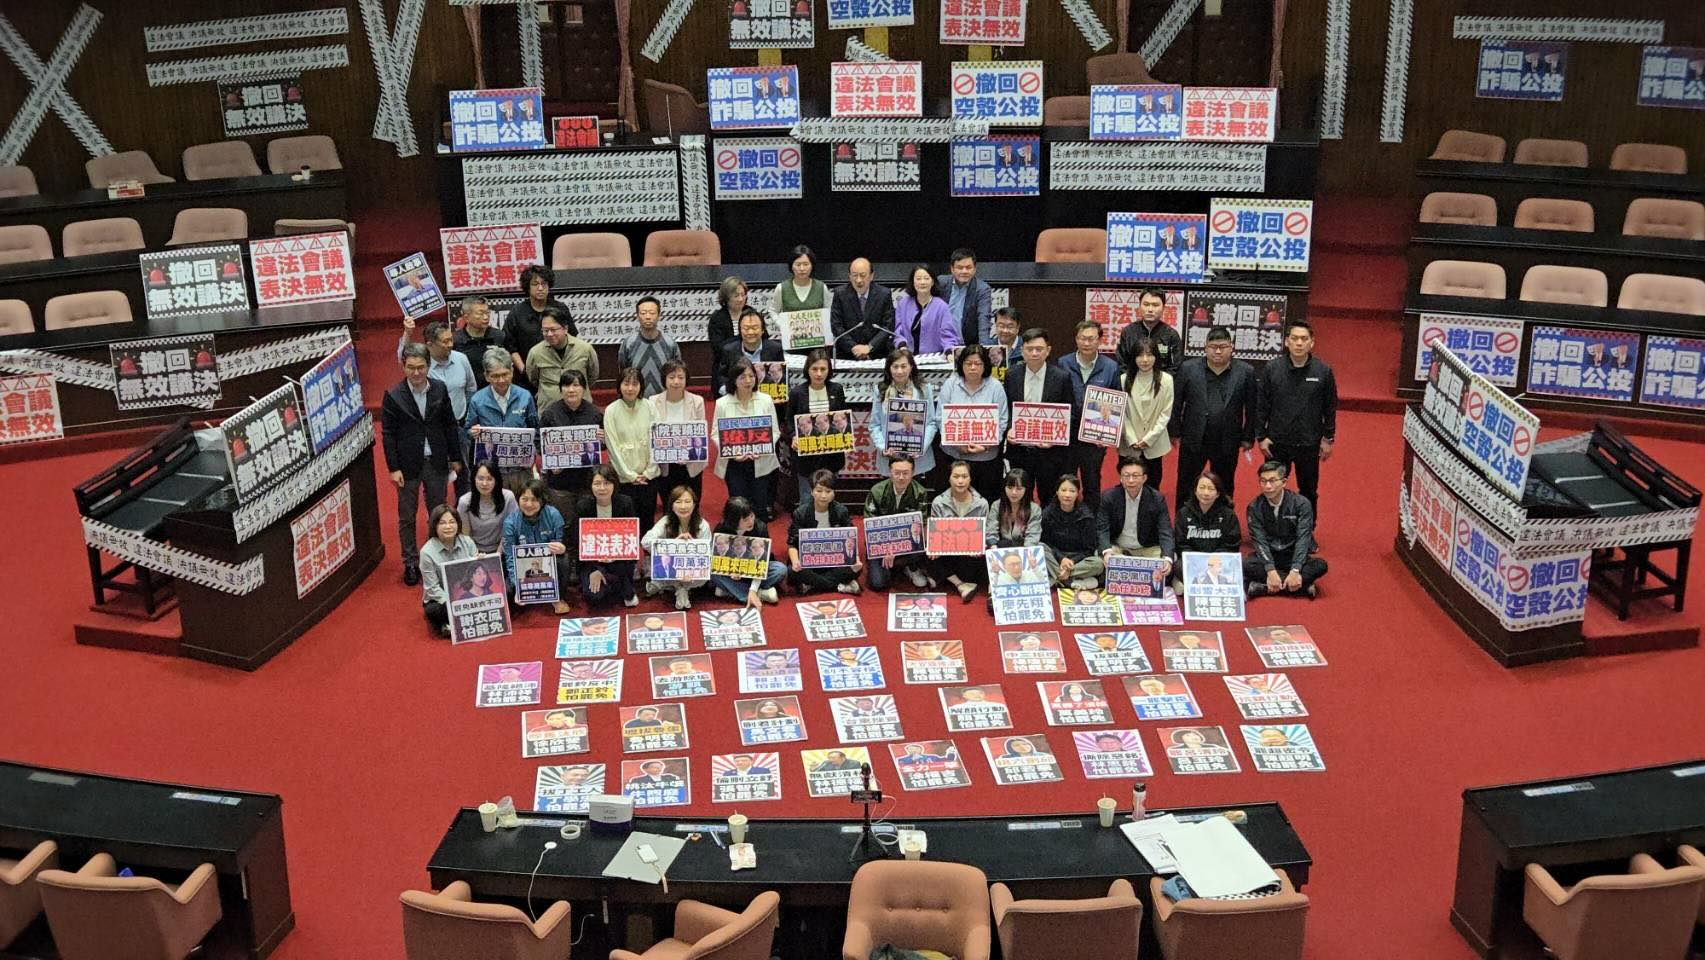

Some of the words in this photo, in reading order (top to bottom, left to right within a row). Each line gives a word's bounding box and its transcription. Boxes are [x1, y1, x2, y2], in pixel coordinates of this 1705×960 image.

[945, 0, 1021, 18] 違法會議
[730, 18, 811, 39] 無效議決
[945, 19, 1021, 39] 表決無效
[1482, 50, 1524, 72] 撤回
[1645, 56, 1688, 78] 撤回
[710, 76, 753, 100] 撤回
[836, 75, 916, 94] 違法會議
[976, 74, 1016, 94] 撤回
[1479, 71, 1564, 95] 詐騙公投
[242, 84, 284, 108] 撤回
[836, 94, 917, 113] 表決無效
[954, 96, 1040, 117] 空殼公投
[1092, 94, 1136, 114] 撤回
[453, 99, 497, 124] 撤回
[711, 100, 798, 123] 詐騙公投
[1186, 100, 1270, 120] 違法會議
[454, 122, 543, 147] 詐騙公投
[1093, 114, 1179, 134] 詐騙公投
[1185, 120, 1270, 139] 表決無效
[738, 150, 779, 169] 撤回
[855, 141, 898, 160] 撤回
[953, 145, 996, 167] 撤回
[719, 171, 801, 191] 空殼公投
[834, 162, 919, 183] 無效議決
[954, 167, 1040, 189] 詐騙公投
[1237, 210, 1283, 234] 撤回
[1109, 224, 1157, 248] 撤回
[1211, 235, 1307, 261] 空殼公投
[255, 248, 345, 278] 違法會議
[447, 238, 537, 265] 違法會議
[1109, 251, 1204, 275] 詐騙公投
[168, 258, 217, 285] 撤回
[149, 281, 245, 312] 無效議決
[259, 271, 349, 299] 表決無效
[1089, 303, 1178, 327] 違法議
[1213, 302, 1261, 328] 撤回
[1188, 326, 1283, 351] 無議決
[1448, 328, 1494, 352] 撤回
[140, 348, 190, 375] 撤回
[1534, 338, 1585, 364] 撤回
[1648, 348, 1701, 374] 撤回
[119, 371, 221, 401] 無效議決
[1531, 362, 1634, 393] 詐騙公投
[0, 389, 54, 413] 會議
[305, 373, 334, 411] 撤回
[1088, 389, 1124, 405] WANTED
[311, 384, 364, 442] 詐騙公投
[1482, 400, 1515, 448] 撤回
[0, 414, 57, 438] 無效
[245, 409, 286, 454] 撤回
[944, 419, 997, 442] 會議無效
[1014, 419, 1068, 442] 會議無效
[236, 429, 309, 494] 無效議決
[1462, 420, 1526, 490] 空殼公投
[295, 498, 350, 560] 違法會議
[582, 533, 638, 556] 違法表決
[1470, 522, 1500, 569] 撤回
[297, 534, 351, 589] 表決無效
[674, 557, 708, 569] 周萬來
[1530, 559, 1580, 590] 撤回
[1002, 597, 1044, 611] 廖先翔
[1004, 608, 1046, 622] 怕罷免
[1195, 606, 1237, 617] 怕罷免
[461, 622, 505, 640] 怕罷免
